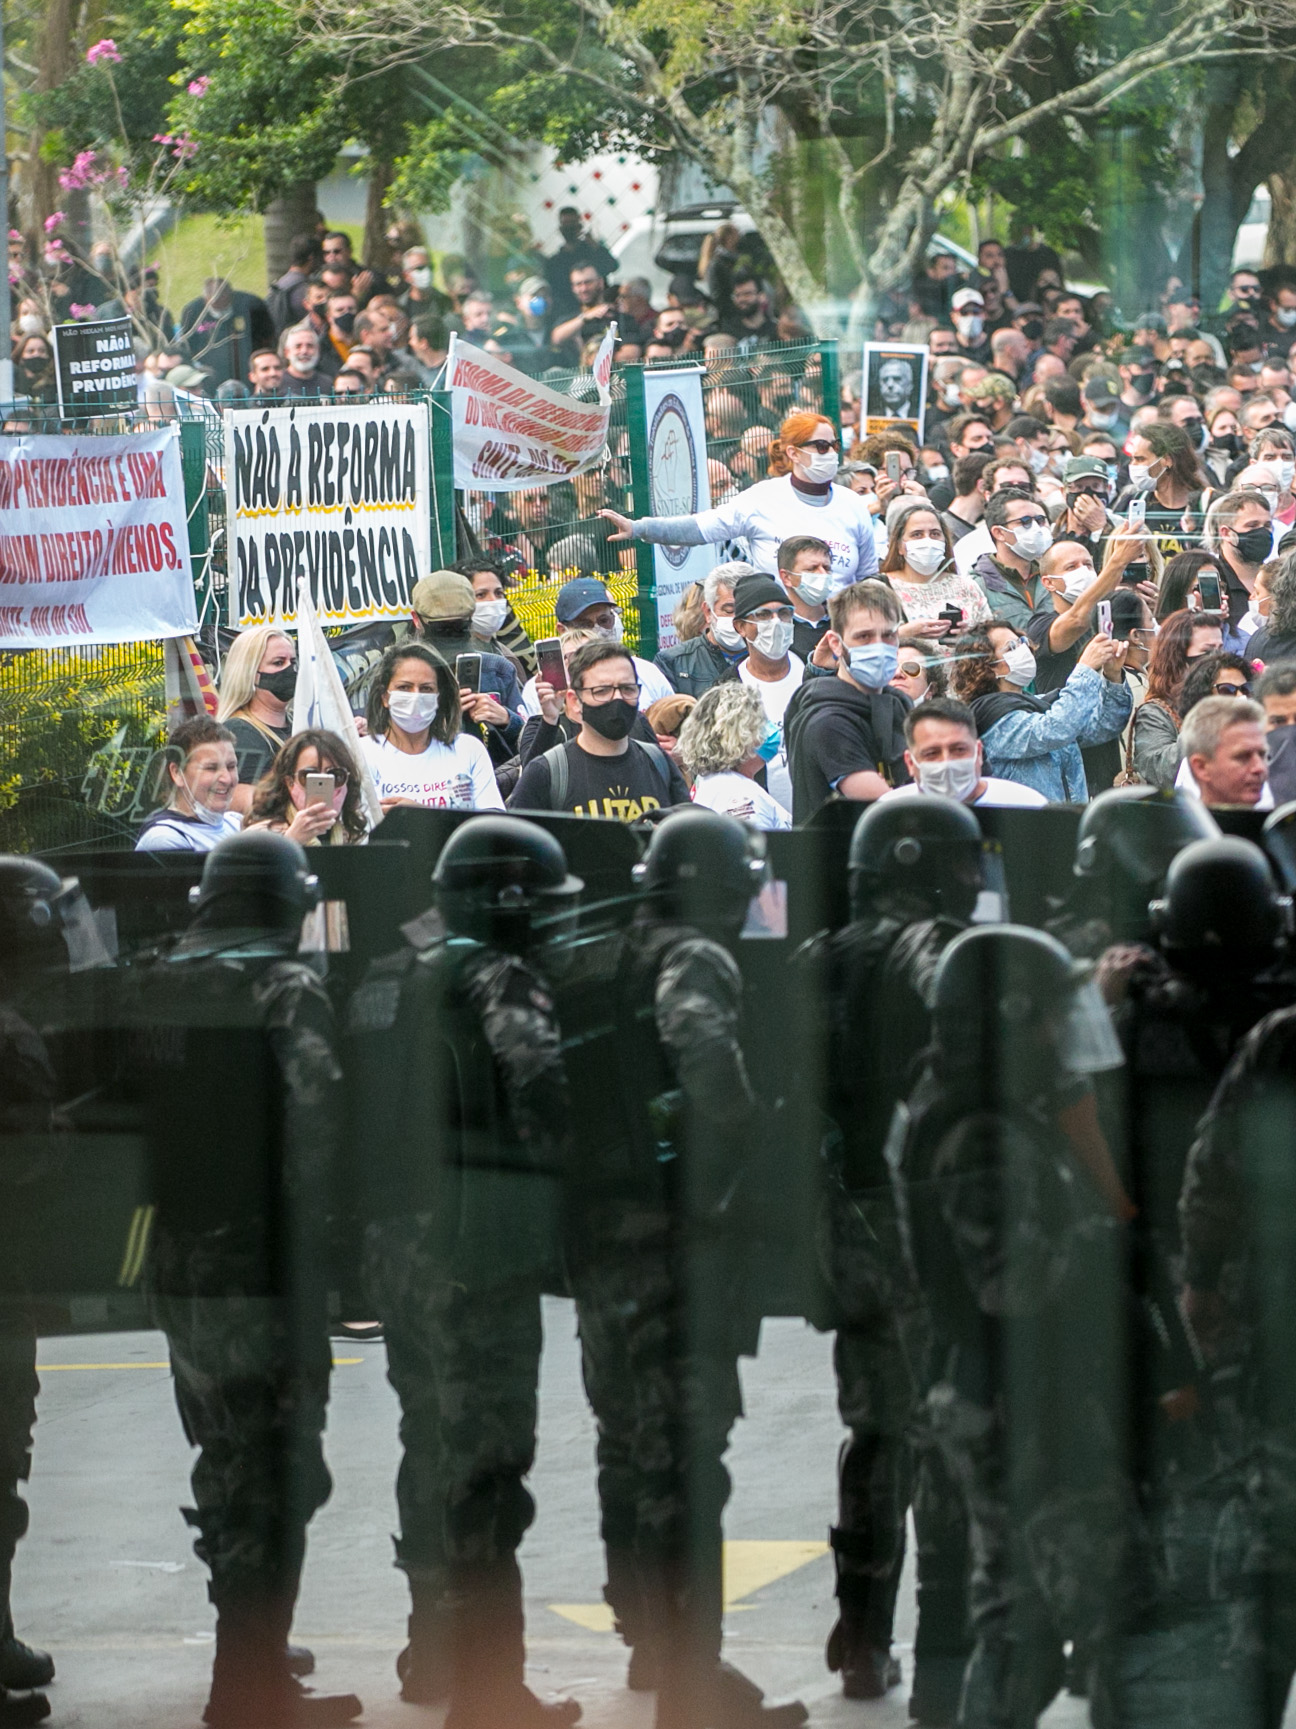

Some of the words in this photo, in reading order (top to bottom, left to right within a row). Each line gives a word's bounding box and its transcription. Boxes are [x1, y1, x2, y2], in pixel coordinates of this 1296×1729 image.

[96, 335, 124, 353] NÃO
[127, 450, 167, 500] UMA
[308, 419, 415, 506] REFORMA
[41, 529, 103, 584] DIREITO
[112, 522, 183, 576] MENOS.
[237, 535, 265, 618] DA
[264, 507, 419, 617] PREVIDÊNCIA
